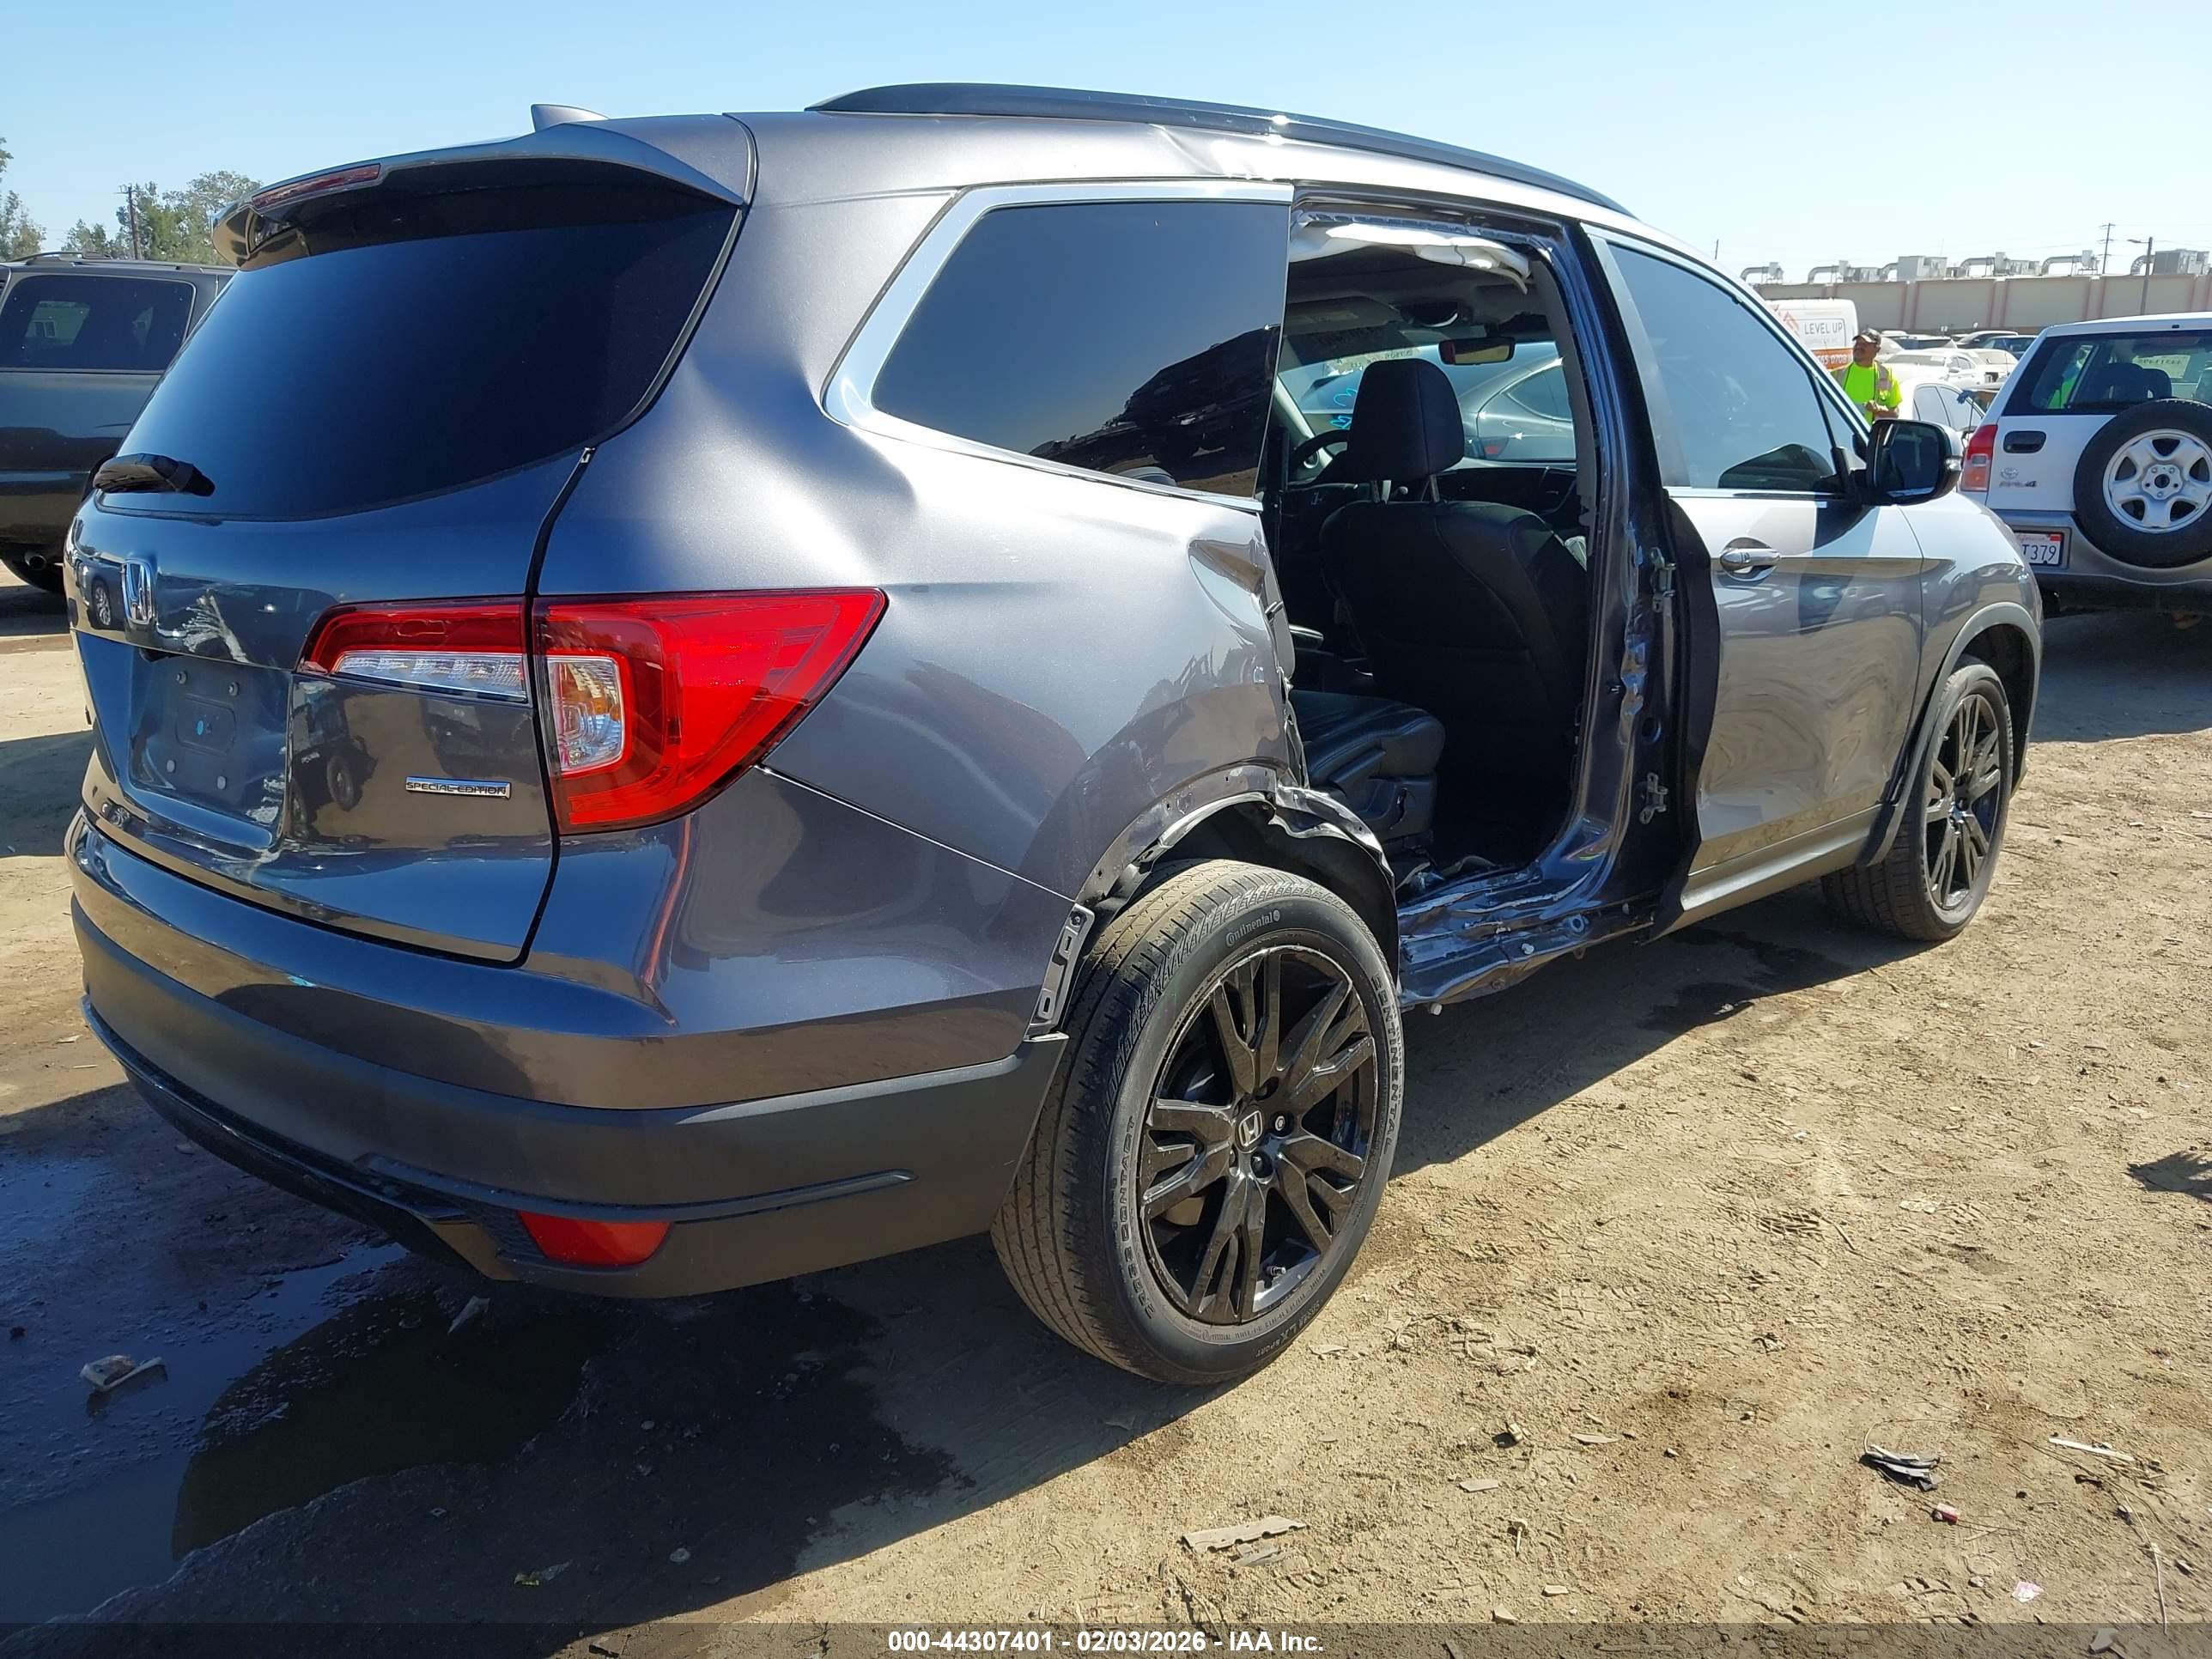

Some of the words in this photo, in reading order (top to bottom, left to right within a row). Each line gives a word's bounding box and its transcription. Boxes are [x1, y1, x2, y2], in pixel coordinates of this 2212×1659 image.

[1804, 322, 1830, 334] LEVEL
[1832, 322, 1843, 333] UP
[1225, 911, 1273, 947] Continental
[1371, 974, 1399, 1155] CONTINENTAL
